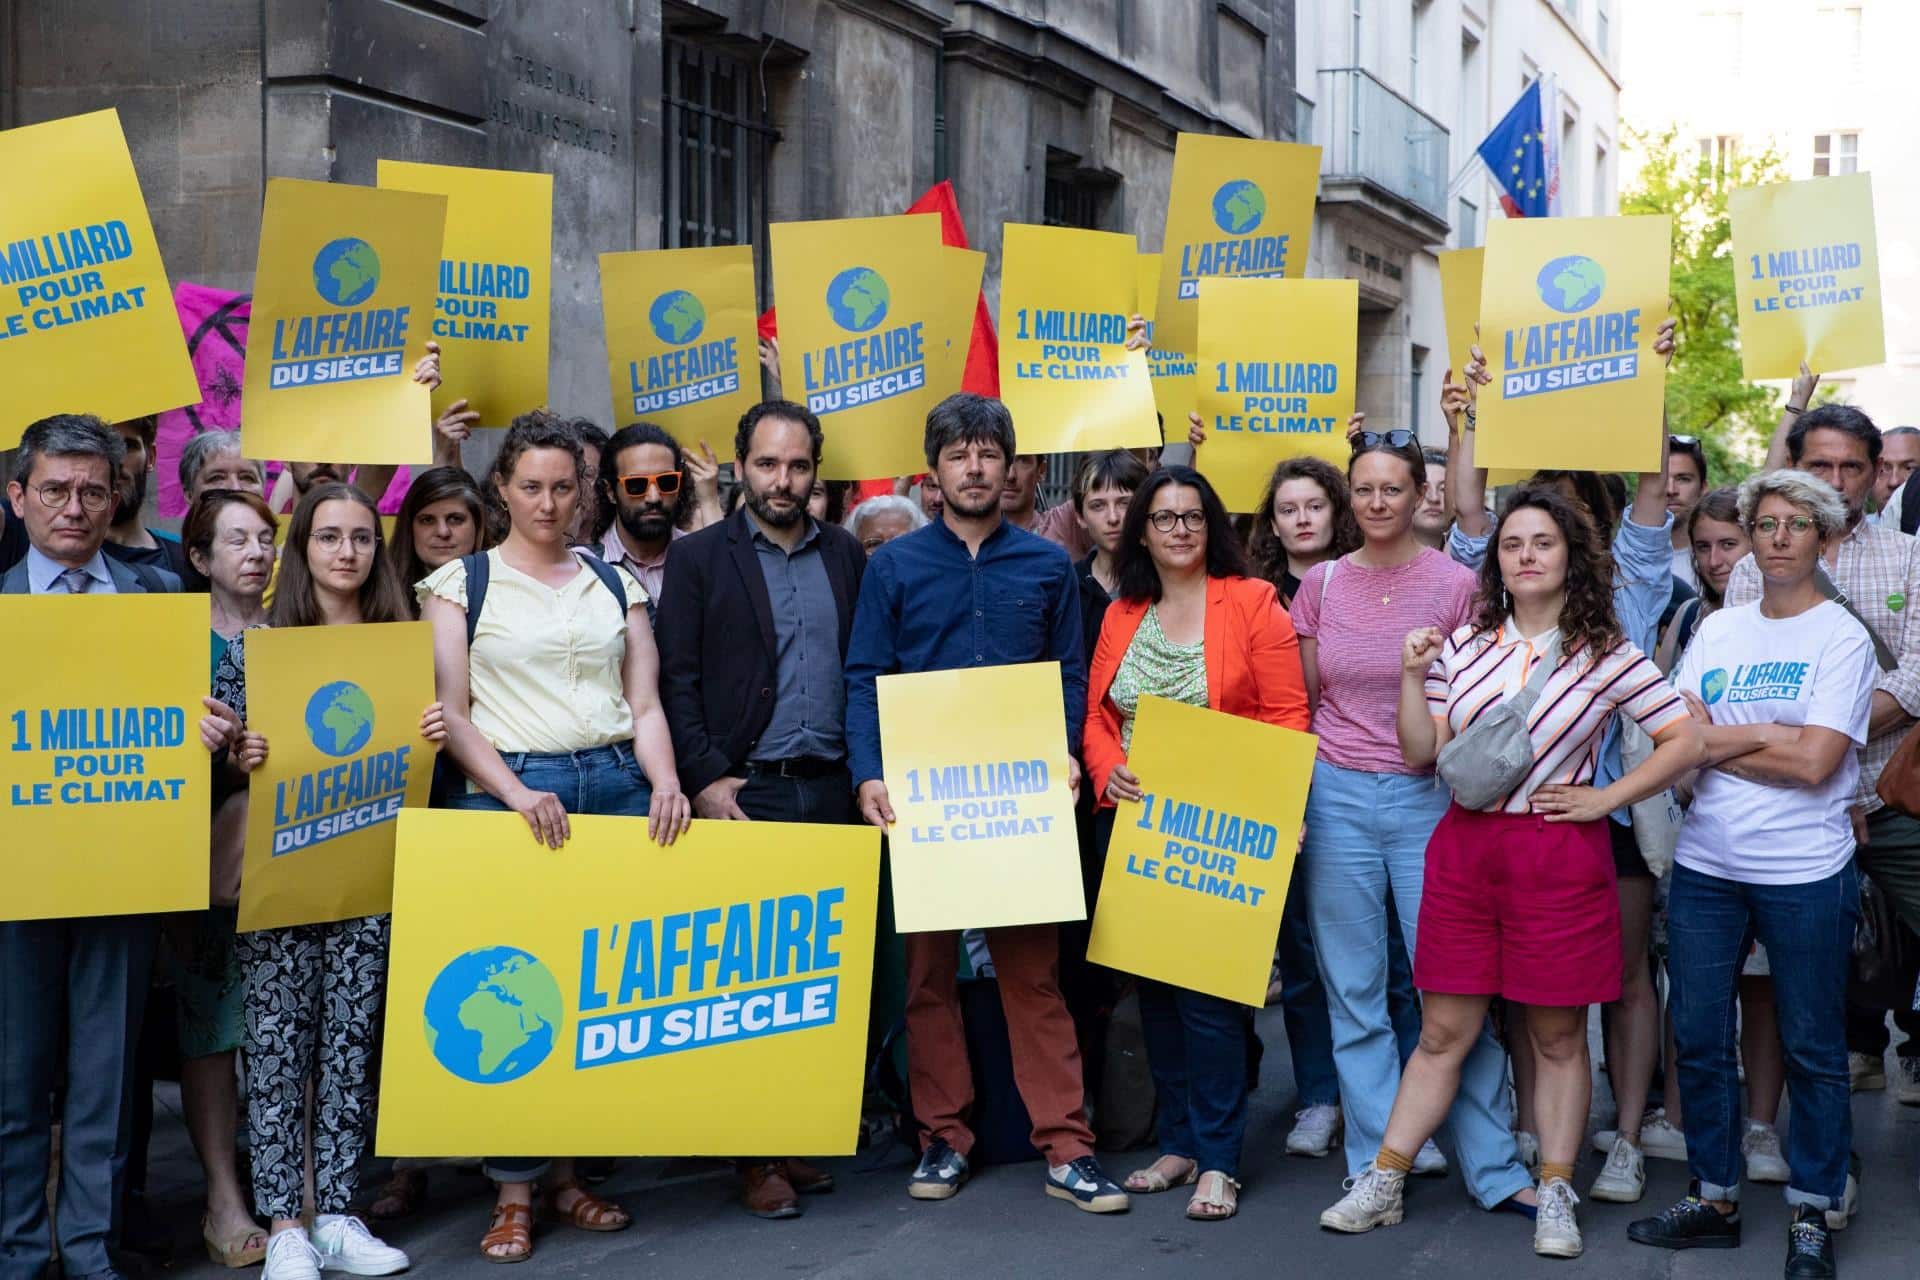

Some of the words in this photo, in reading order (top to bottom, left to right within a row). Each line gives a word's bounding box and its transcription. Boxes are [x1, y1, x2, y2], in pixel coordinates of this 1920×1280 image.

[512, 56, 596, 105] TRIBUNAL
[0, 220, 133, 285] MILLIARD
[1180, 235, 1290, 278] L'AFFAIRE
[1751, 254, 1765, 280] 1
[1768, 243, 1861, 278] MILLIARD
[17, 271, 104, 308] POUR
[439, 259, 530, 300] ILLIARD
[1181, 281, 1200, 297] D
[1779, 274, 1837, 294] POUR
[32, 286, 146, 330] CLIMAT
[1754, 297, 1780, 313] LE
[1784, 286, 1865, 310] CLIMAT
[272, 306, 411, 361] L'AFFAIRE
[431, 318, 529, 343] CLIMAT
[1016, 309, 1029, 340] 1
[1034, 310, 1127, 345] MILLIARD
[1503, 308, 1641, 371] L'AFFAIRE
[272, 364, 309, 386] DU
[314, 353, 401, 381] SIÈCLE
[629, 336, 738, 393] L'AFFAIRE
[803, 321, 924, 391] L'AFFAIRE
[1016, 363, 1043, 378] LE
[1047, 363, 1130, 380] CLIMAT
[1043, 345, 1101, 362] POUR
[635, 394, 664, 413] DU
[667, 374, 737, 405] SIÈCLE
[809, 391, 841, 414] DU
[846, 367, 923, 405] SIÈCLE
[1215, 362, 1230, 393] 1
[1235, 362, 1337, 394] MILLIARD
[1506, 373, 1542, 396] DU
[1545, 356, 1635, 389] SIÈCLE
[1244, 396, 1308, 413] POUR
[1215, 415, 1243, 431] LE
[1248, 415, 1337, 433] CLIMAT
[1731, 661, 1810, 687] L'AFFAIRE
[1729, 689, 1750, 701] DU
[11, 709, 32, 751] 1
[40, 706, 185, 751] MILLIARD
[54, 753, 145, 777] POUR
[906, 768, 925, 803] 1
[929, 759, 1049, 801] MILLIARD
[11, 783, 53, 806] LE
[60, 778, 186, 804] CLIMAT
[274, 745, 411, 826] L'AFFAIRE
[275, 824, 312, 853] DU
[316, 795, 401, 839] SIÈCLE
[911, 825, 945, 843] LE
[950, 815, 1054, 841] CLIMAT
[943, 799, 1018, 822] POUR
[1136, 793, 1155, 830] 1
[1158, 798, 1278, 861] MILLIARD
[1164, 840, 1237, 876] POUR
[1126, 854, 1160, 880] LE
[1164, 865, 1266, 907] CLIMAT
[578, 886, 845, 1013] L'AFFAIRE
[582, 1014, 652, 1062] DU
[659, 983, 832, 1046] SIÈCLE
